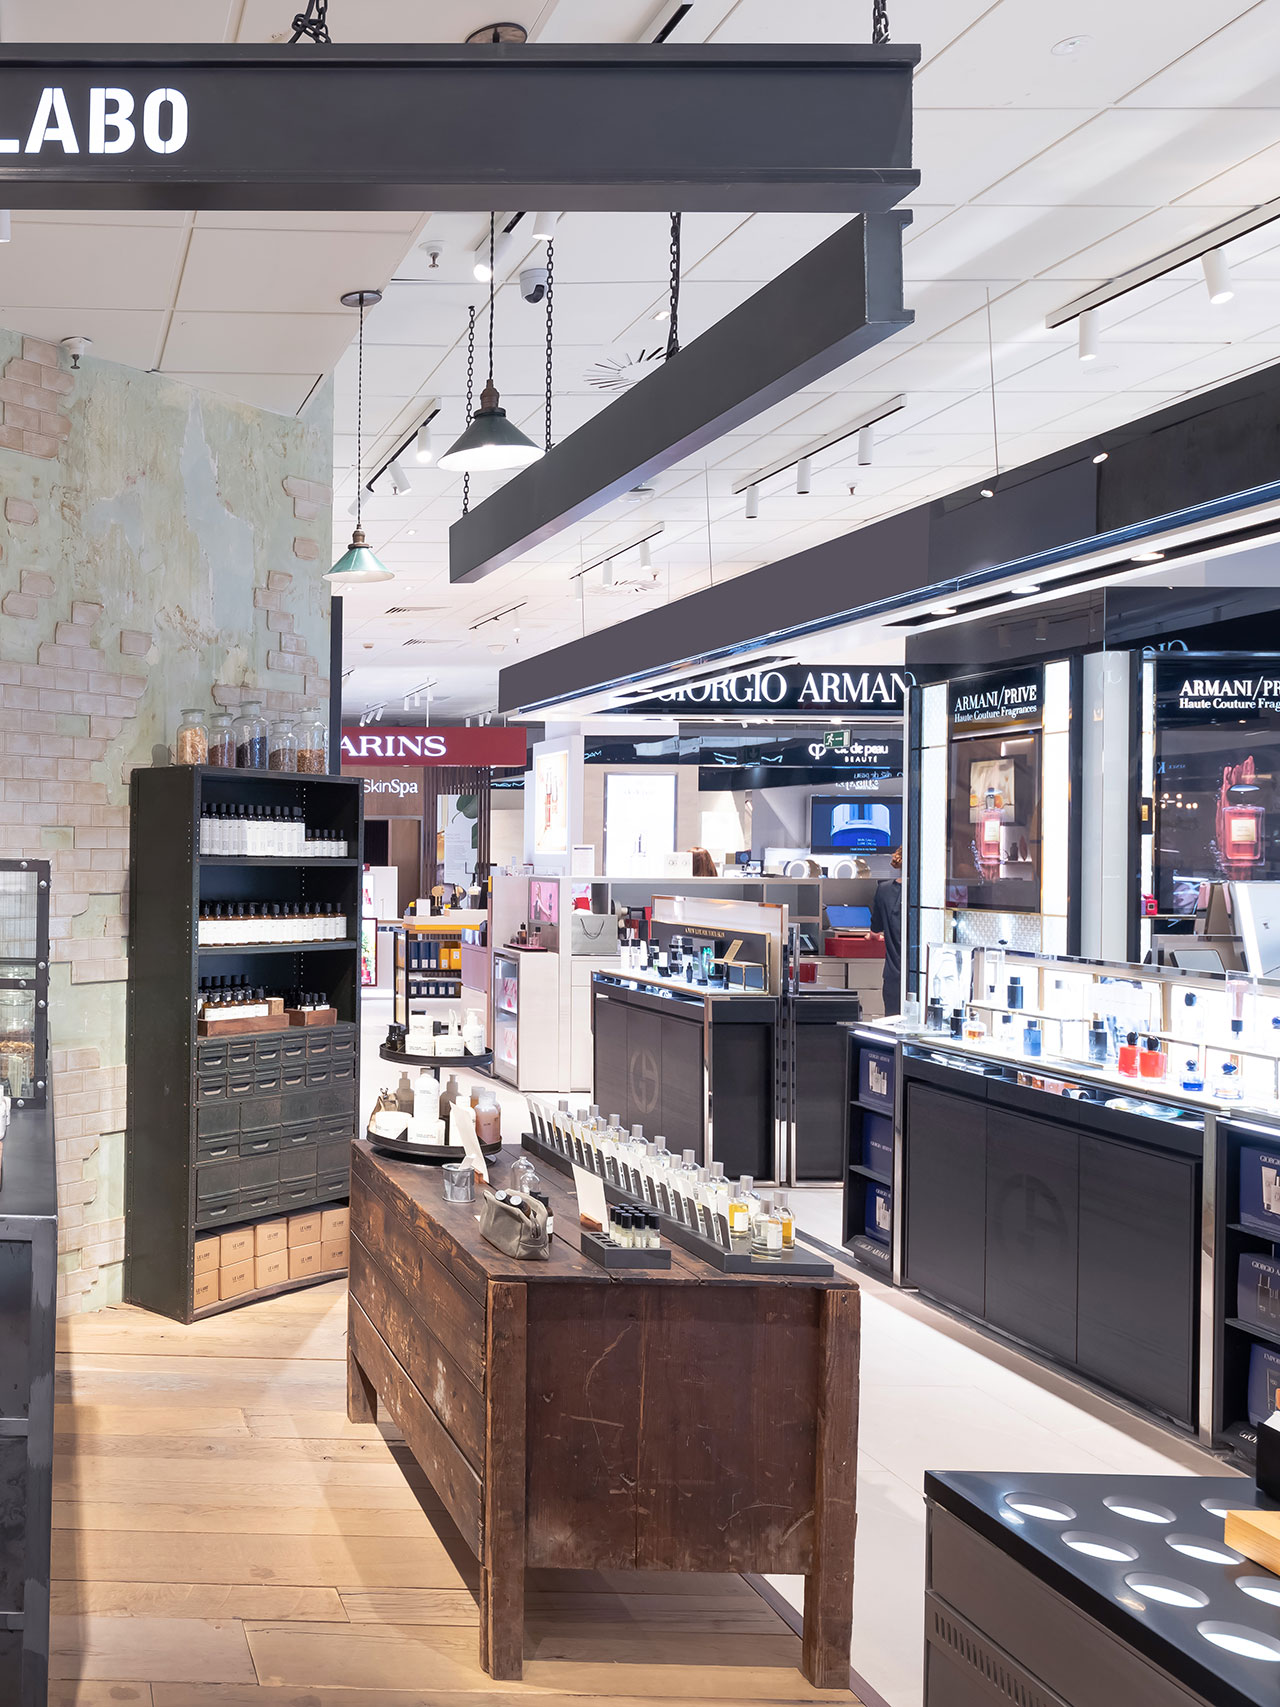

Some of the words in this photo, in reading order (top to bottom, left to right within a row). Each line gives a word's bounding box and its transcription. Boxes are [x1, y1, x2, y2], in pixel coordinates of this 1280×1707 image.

[658, 672, 787, 703] ORGIO
[798, 672, 906, 703] ARMAN
[1179, 675, 1280, 700] ARMANI/PR
[1179, 697, 1211, 709] Haute
[1212, 697, 1256, 709] Couture
[954, 713, 973, 723] Haute
[973, 710, 1000, 721] Couture
[1001, 704, 1037, 719] Fragrances
[340, 735, 447, 757] ARINS
[864, 745, 888, 757] peau
[363, 779, 418, 798] SkinSpa
